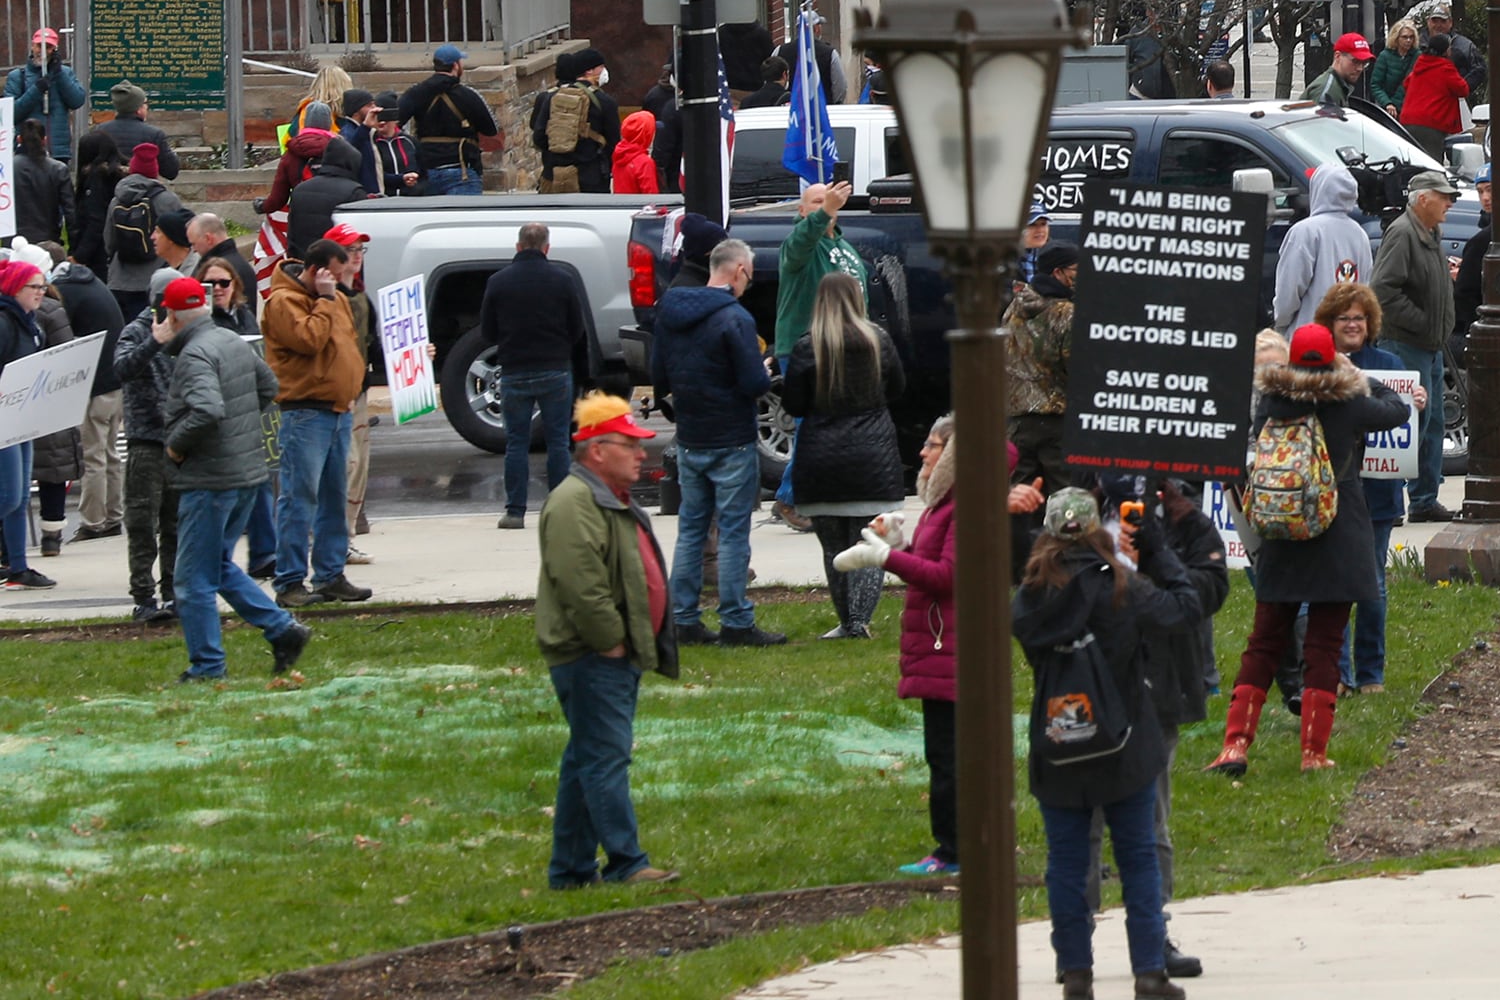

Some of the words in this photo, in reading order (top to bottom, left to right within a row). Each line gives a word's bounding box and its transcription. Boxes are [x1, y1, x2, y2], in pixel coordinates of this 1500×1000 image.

[1110, 189, 1127, 205] "I
[1131, 190, 1162, 207] AM
[1167, 193, 1231, 212] BEING
[1093, 210, 1175, 231] PROVEN
[1181, 216, 1245, 236] RIGHT
[1084, 233, 1155, 252] ABOUT
[1159, 238, 1250, 259] MASSIVE
[1092, 255, 1245, 281] VACCINATIONS
[382, 288, 402, 322] LET
[1144, 304, 1186, 322] THE
[384, 313, 427, 354] PEOPLE
[1089, 323, 1187, 346] DOCTORS
[1191, 330, 1238, 349] LIED
[1106, 370, 1160, 389] SAVE
[1164, 374, 1209, 392] OUR
[1093, 392, 1196, 414] CHILDREN
[1201, 399, 1217, 416] &
[1078, 413, 1140, 433] THEIR
[1145, 418, 1236, 439] FUTURE"
[1114, 457, 1151, 469] TRUMP
[1153, 461, 1170, 471] ON
[1172, 462, 1200, 474] SEPT
